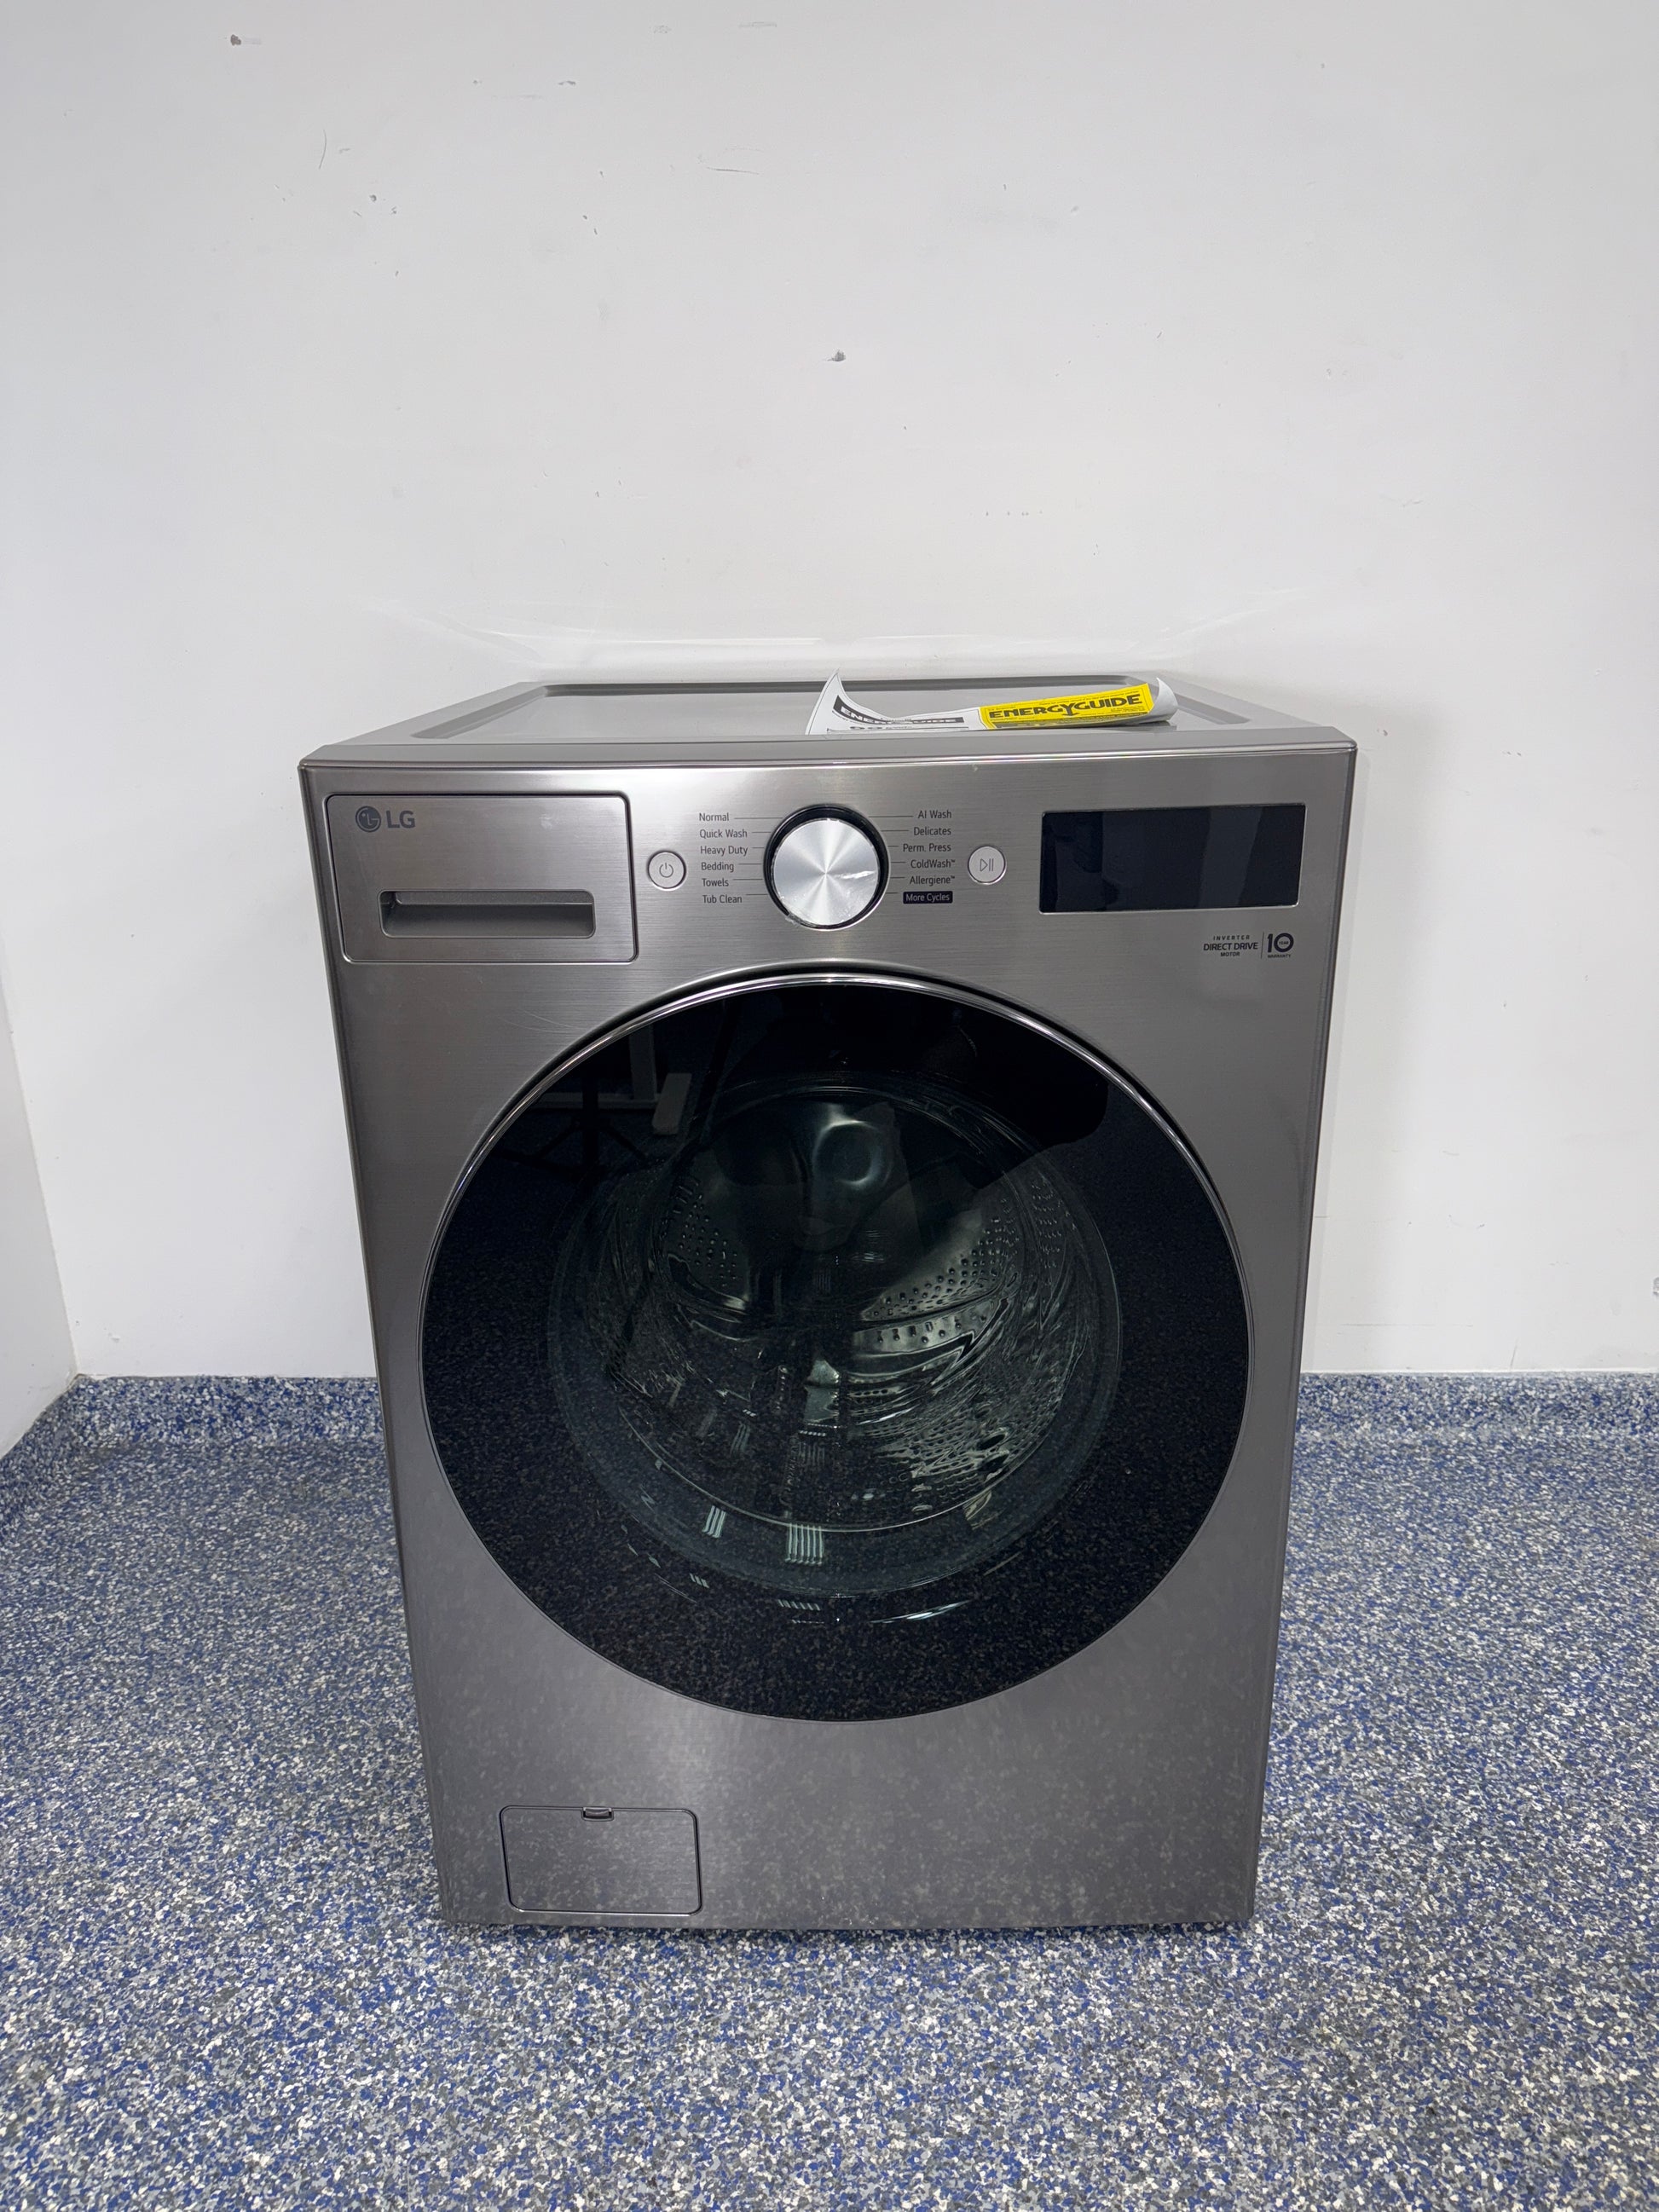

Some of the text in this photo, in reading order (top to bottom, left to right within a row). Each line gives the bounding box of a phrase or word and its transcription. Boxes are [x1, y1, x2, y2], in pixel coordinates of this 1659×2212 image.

[988, 694, 1143, 719] ENERGYGUIDE
[699, 812, 730, 822] Normal
[917, 810, 952, 818] AI Wash
[385, 810, 416, 829] LG
[699, 829, 748, 839] Quick Wash
[913, 826, 951, 836] Delicates
[700, 845, 749, 857] Heavy Duty
[903, 843, 951, 852] Perm. Press
[701, 862, 735, 873] Bedding
[702, 878, 730, 887] Towels
[702, 893, 743, 904] Tub Clean
[905, 892, 951, 903] More Cycles
[1203, 942, 1259, 951] DIRECT DRIVE
[1267, 933, 1294, 953] 10
